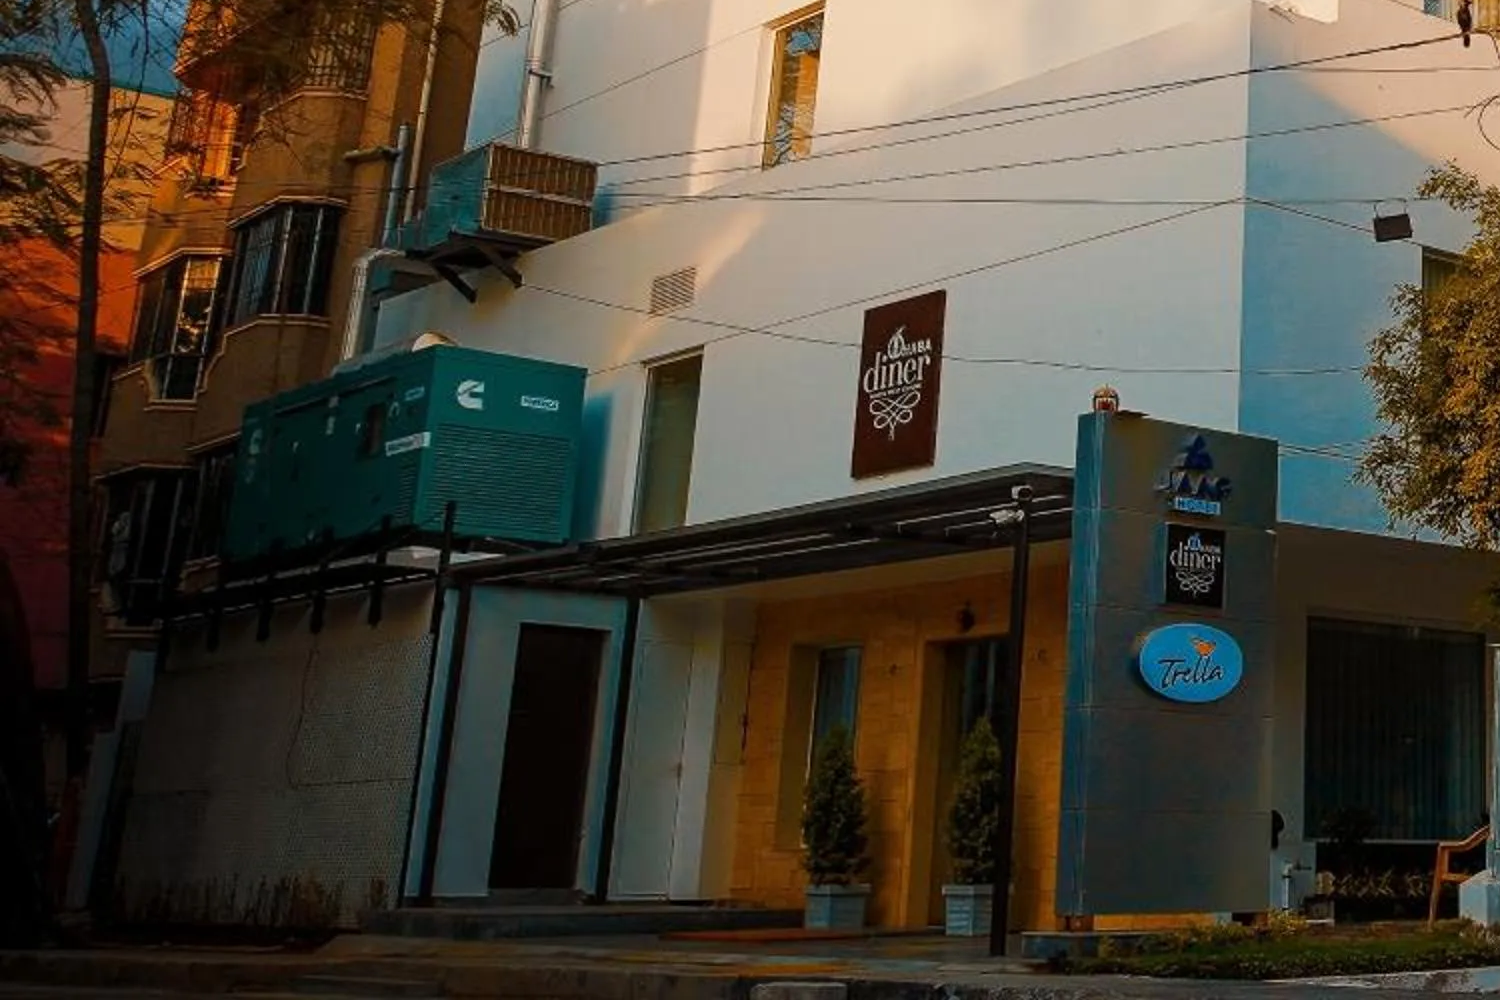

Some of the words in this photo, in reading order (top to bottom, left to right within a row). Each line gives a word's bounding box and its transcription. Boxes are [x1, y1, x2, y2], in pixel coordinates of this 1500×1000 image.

[863, 351, 931, 394] diner
[1169, 541, 1221, 569] diner
[1158, 656, 1224, 689] Trella
